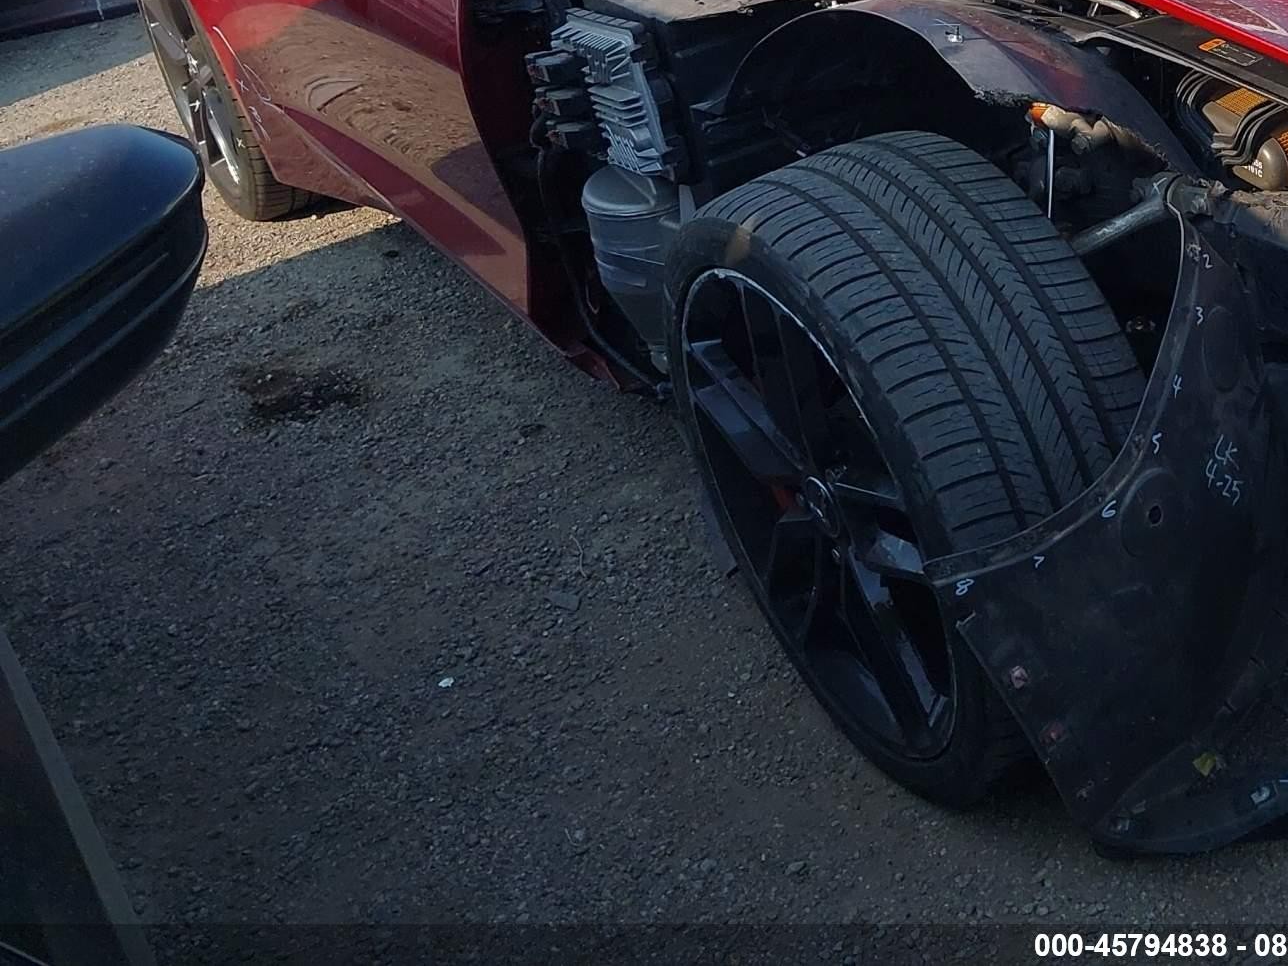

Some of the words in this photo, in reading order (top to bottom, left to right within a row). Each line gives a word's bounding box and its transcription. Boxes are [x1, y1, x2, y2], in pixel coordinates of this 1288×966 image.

[1202, 253, 1213, 269] 2
[1195, 306, 1204, 325] 3
[1173, 374, 1183, 399] 4
[1205, 458, 1244, 506] 4-25
[1101, 500, 1118, 518] 6
[1033, 556, 1045, 569] 7
[955, 578, 975, 596] 8
